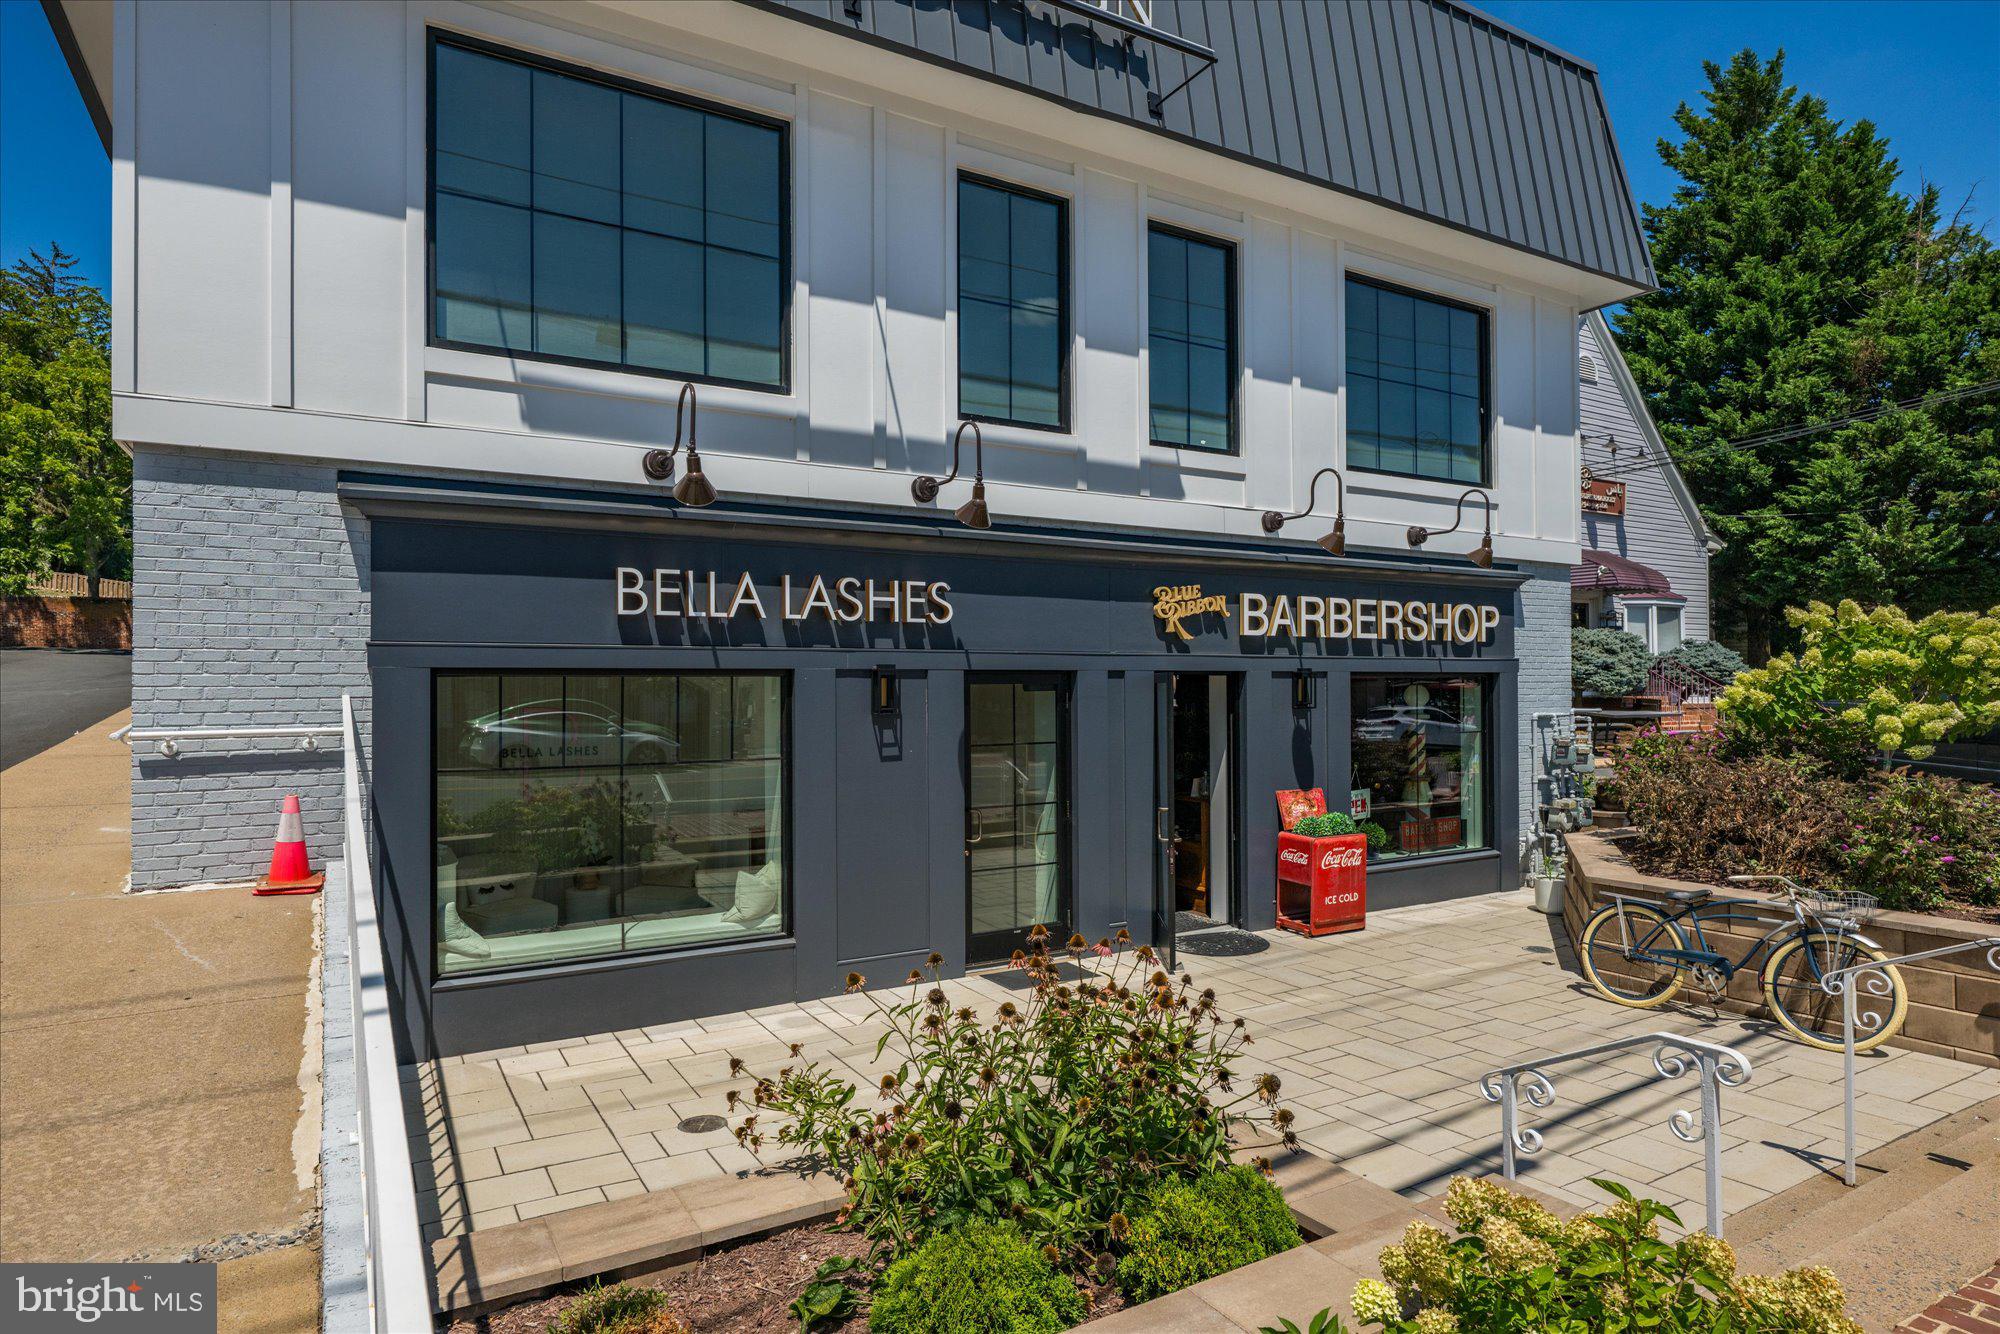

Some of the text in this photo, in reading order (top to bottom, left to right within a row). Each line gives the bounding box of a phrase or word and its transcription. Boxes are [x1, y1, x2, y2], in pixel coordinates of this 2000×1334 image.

[616, 566, 954, 624] BELLA LASHES
[1153, 584, 1201, 602] BLUE
[1153, 595, 1231, 640] RIBBON
[1239, 592, 1500, 643] BARBERSHOP
[502, 745, 599, 758] BELLA LASHES
[1438, 820, 1457, 833] SHOP
[1325, 892, 1359, 905] ICE COLD
